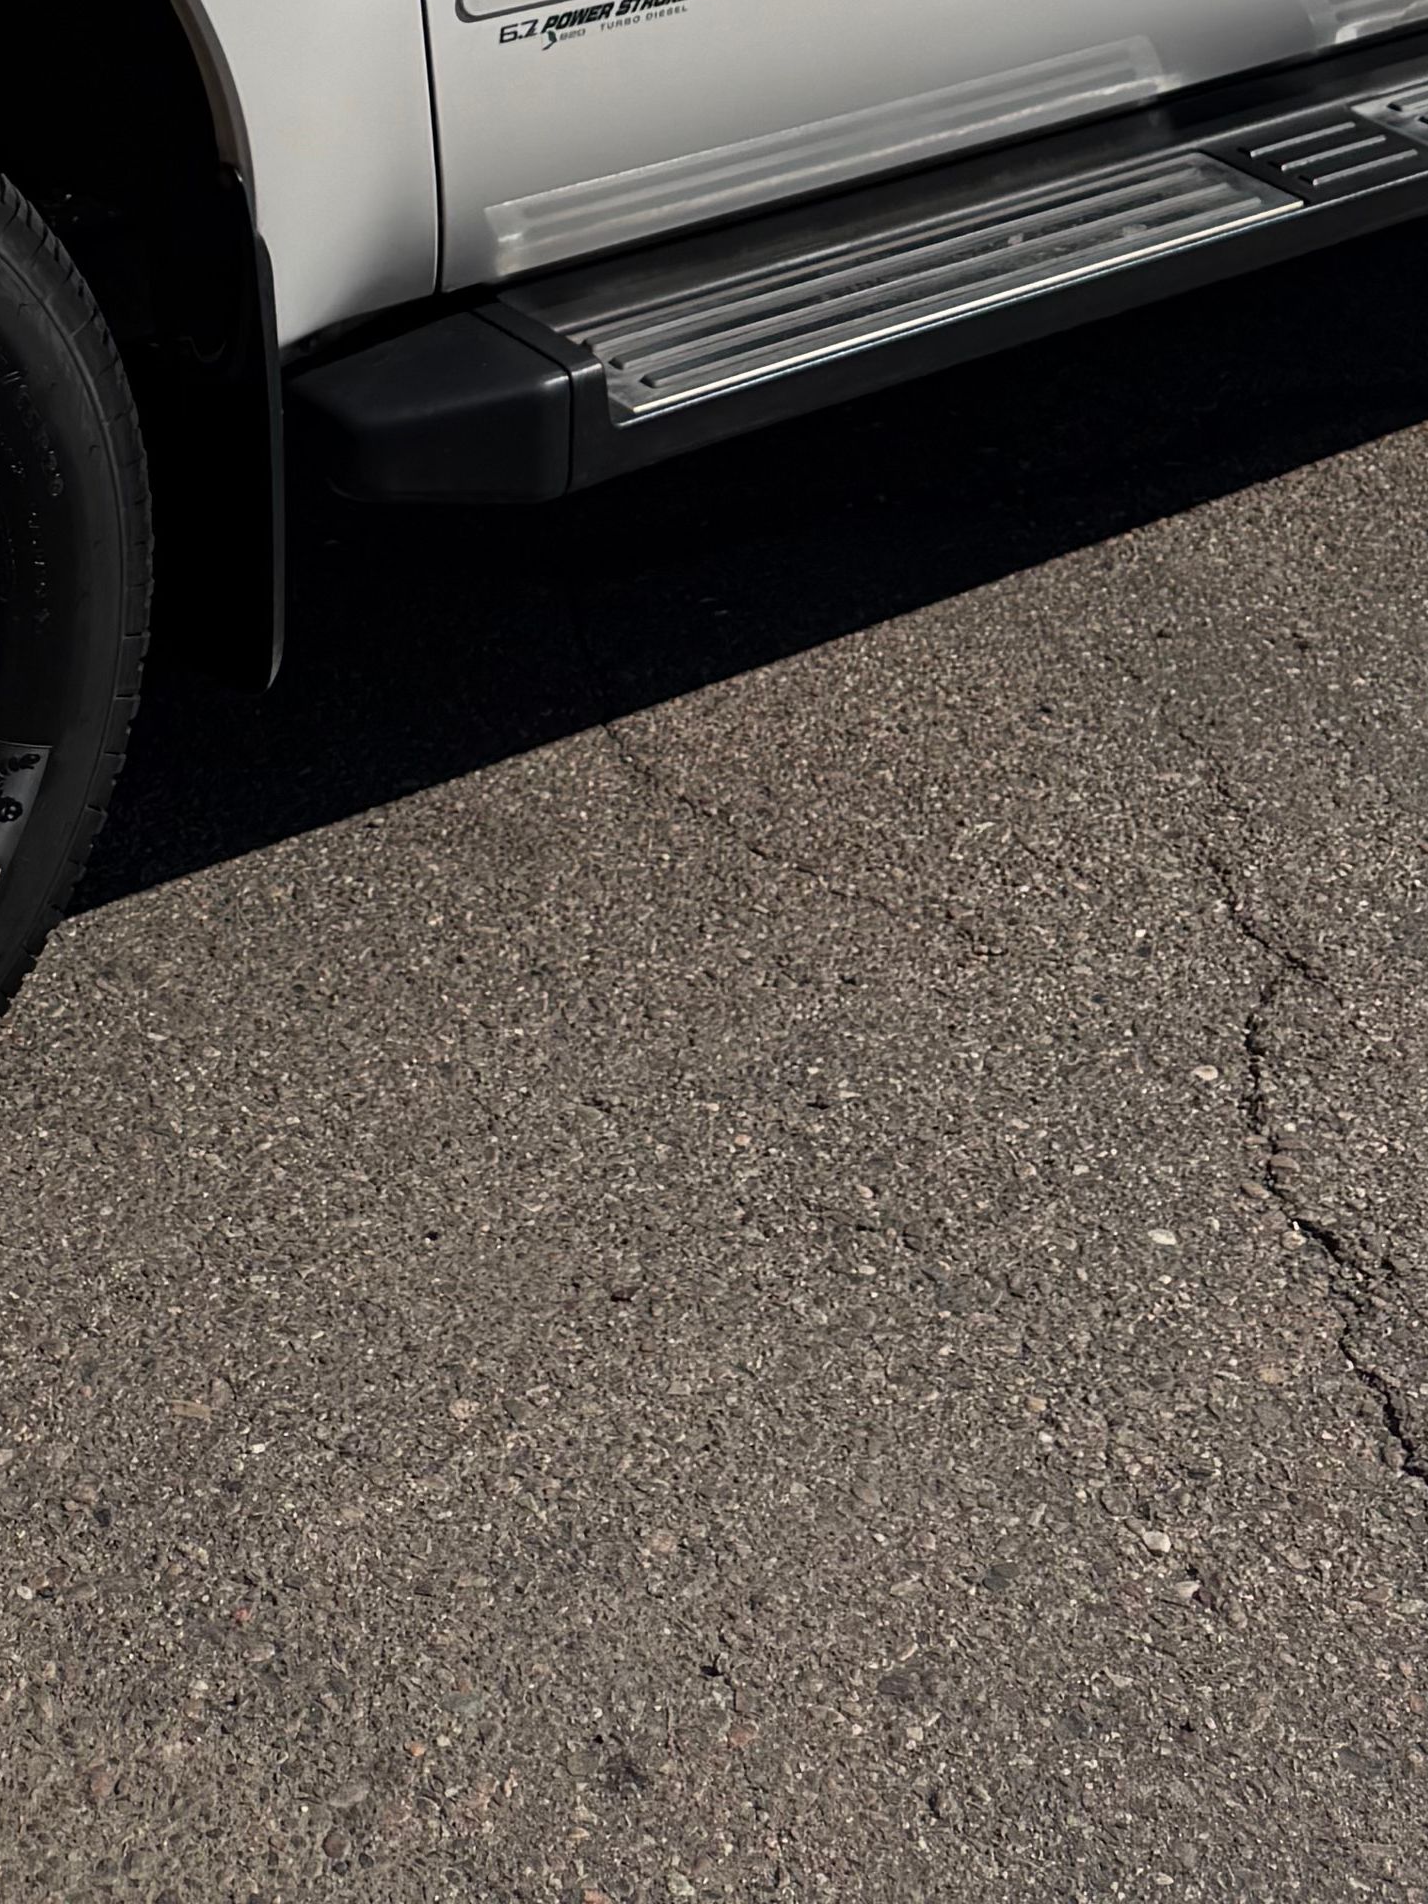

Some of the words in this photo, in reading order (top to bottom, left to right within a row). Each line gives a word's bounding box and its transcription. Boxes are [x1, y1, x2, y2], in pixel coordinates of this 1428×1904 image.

[499, 19, 539, 44] 6.7
[539, 1, 615, 34] POWER
[600, 15, 641, 32] TURBO
[645, 5, 688, 21] DIESEL
